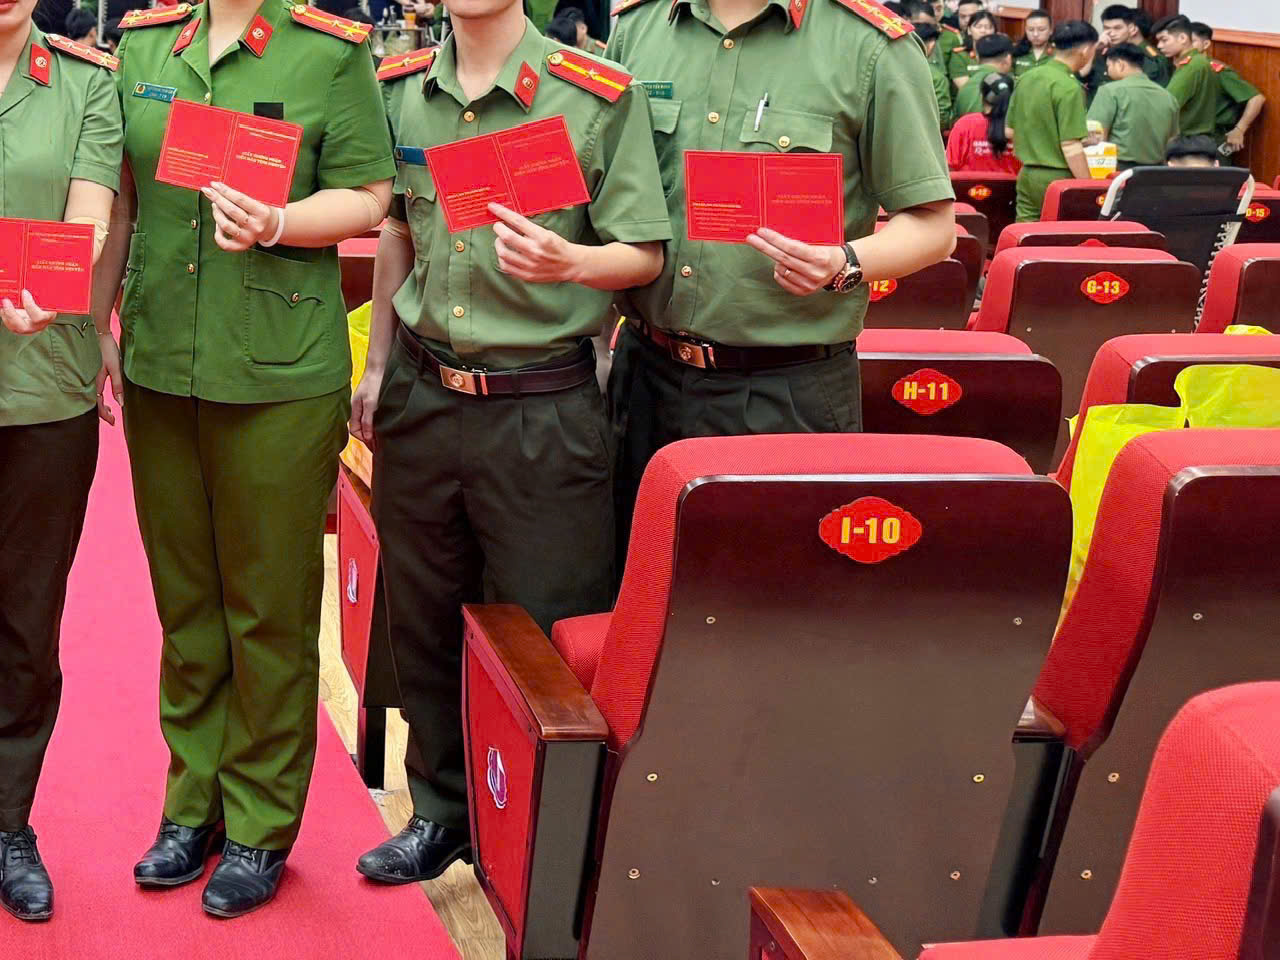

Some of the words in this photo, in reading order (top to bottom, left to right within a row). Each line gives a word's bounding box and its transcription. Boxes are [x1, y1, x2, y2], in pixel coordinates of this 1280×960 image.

[1086, 280, 1121, 294] G-13
[903, 381, 949, 400] H-11
[840, 516, 901, 544] I-10
